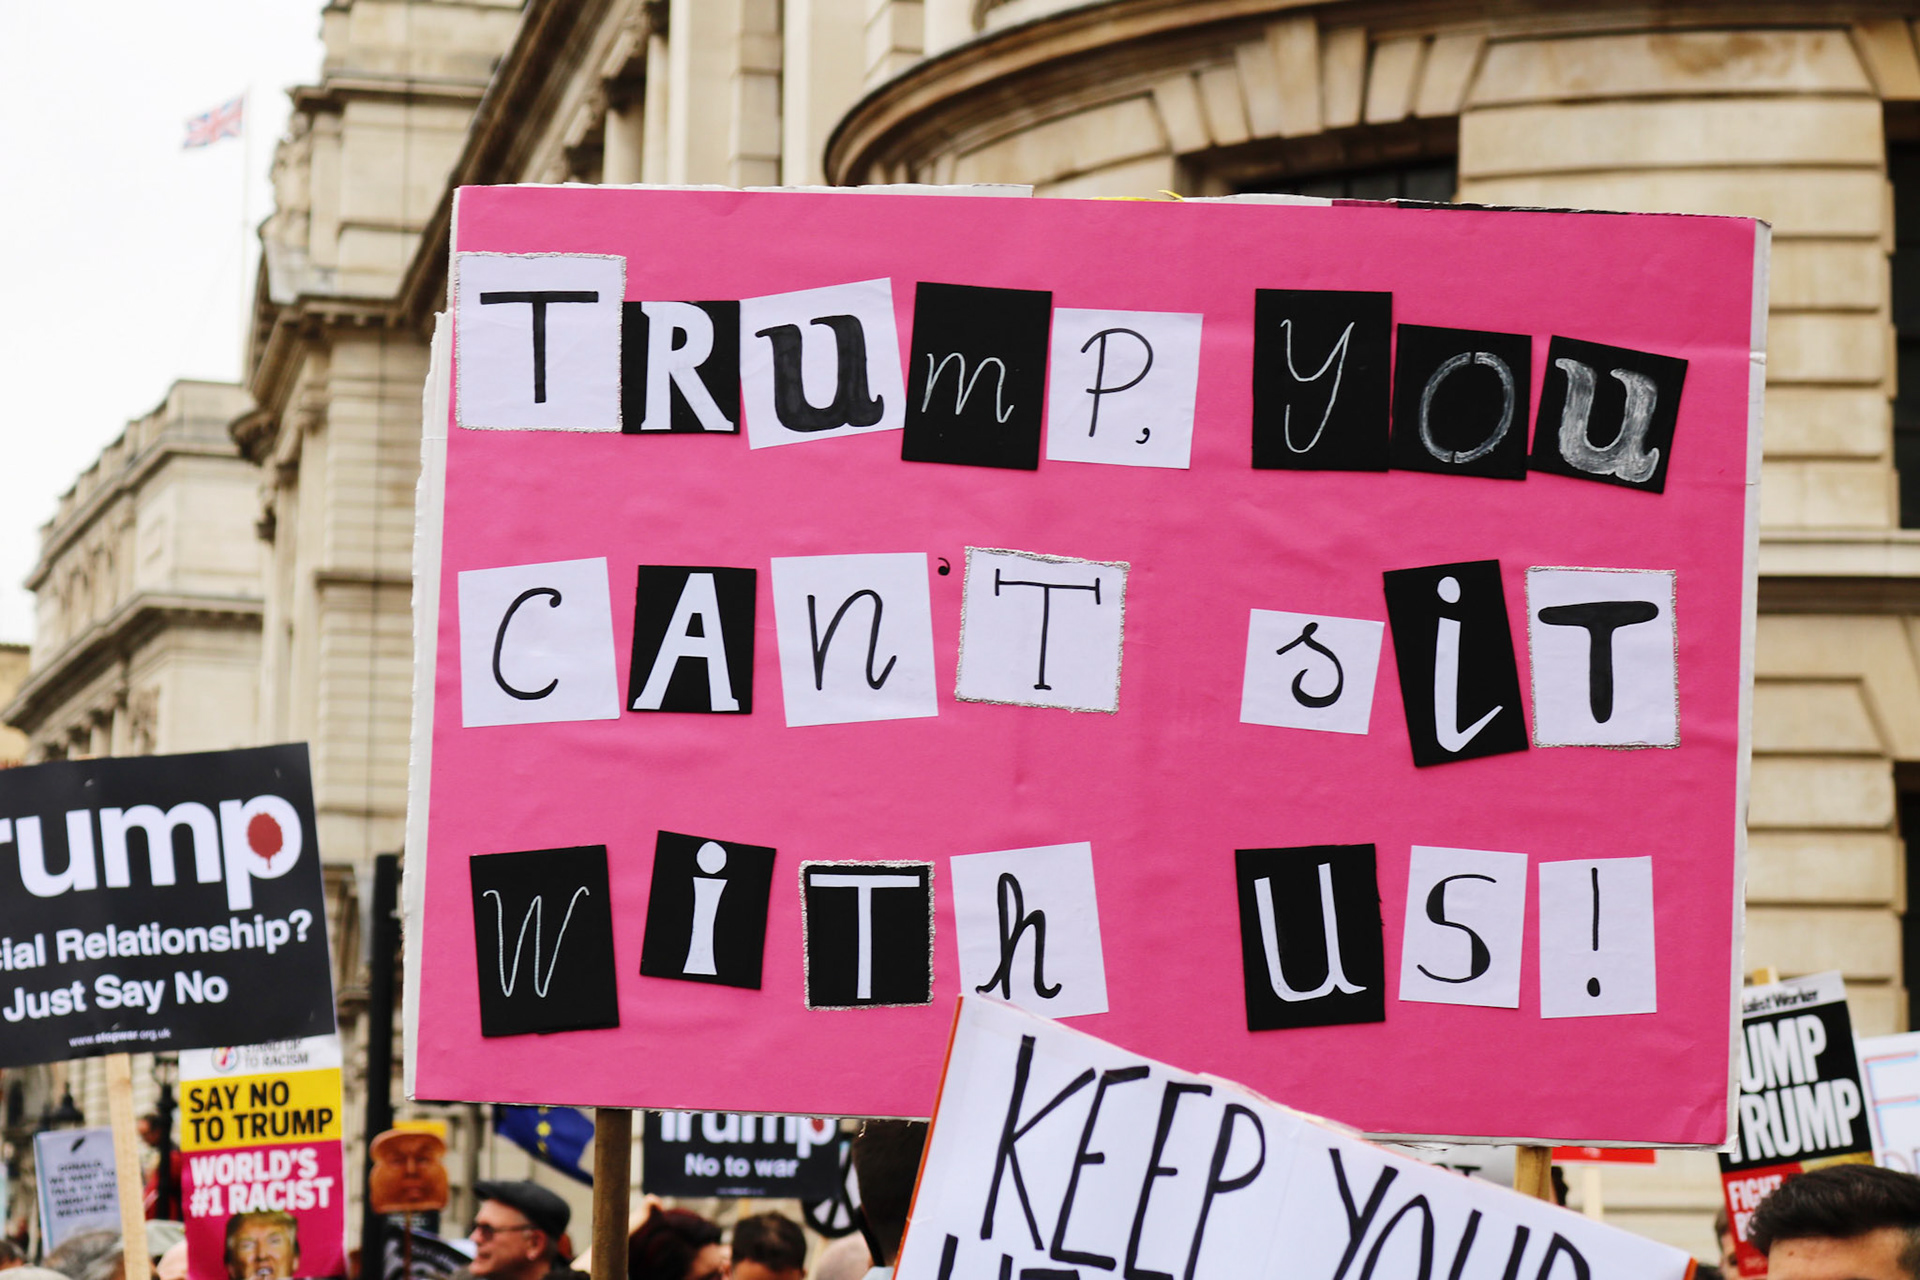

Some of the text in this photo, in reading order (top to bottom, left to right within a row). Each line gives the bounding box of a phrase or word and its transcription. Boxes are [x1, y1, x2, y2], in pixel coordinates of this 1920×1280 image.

[0, 909, 313, 971] ial Relationship?
[3, 970, 229, 1022] Just Say No
[69, 1028, 171, 1048] www.stopwar.org.uk
[263, 1053, 309, 1067] RACISM
[190, 1081, 290, 1114] SAY NO
[189, 1108, 334, 1144] TO TRUMP
[190, 1147, 319, 1187] WORLD'S
[684, 1152, 799, 1178] No to war
[980, 1035, 1266, 1280] KEEP
[190, 1176, 334, 1218] #1 RACIST
